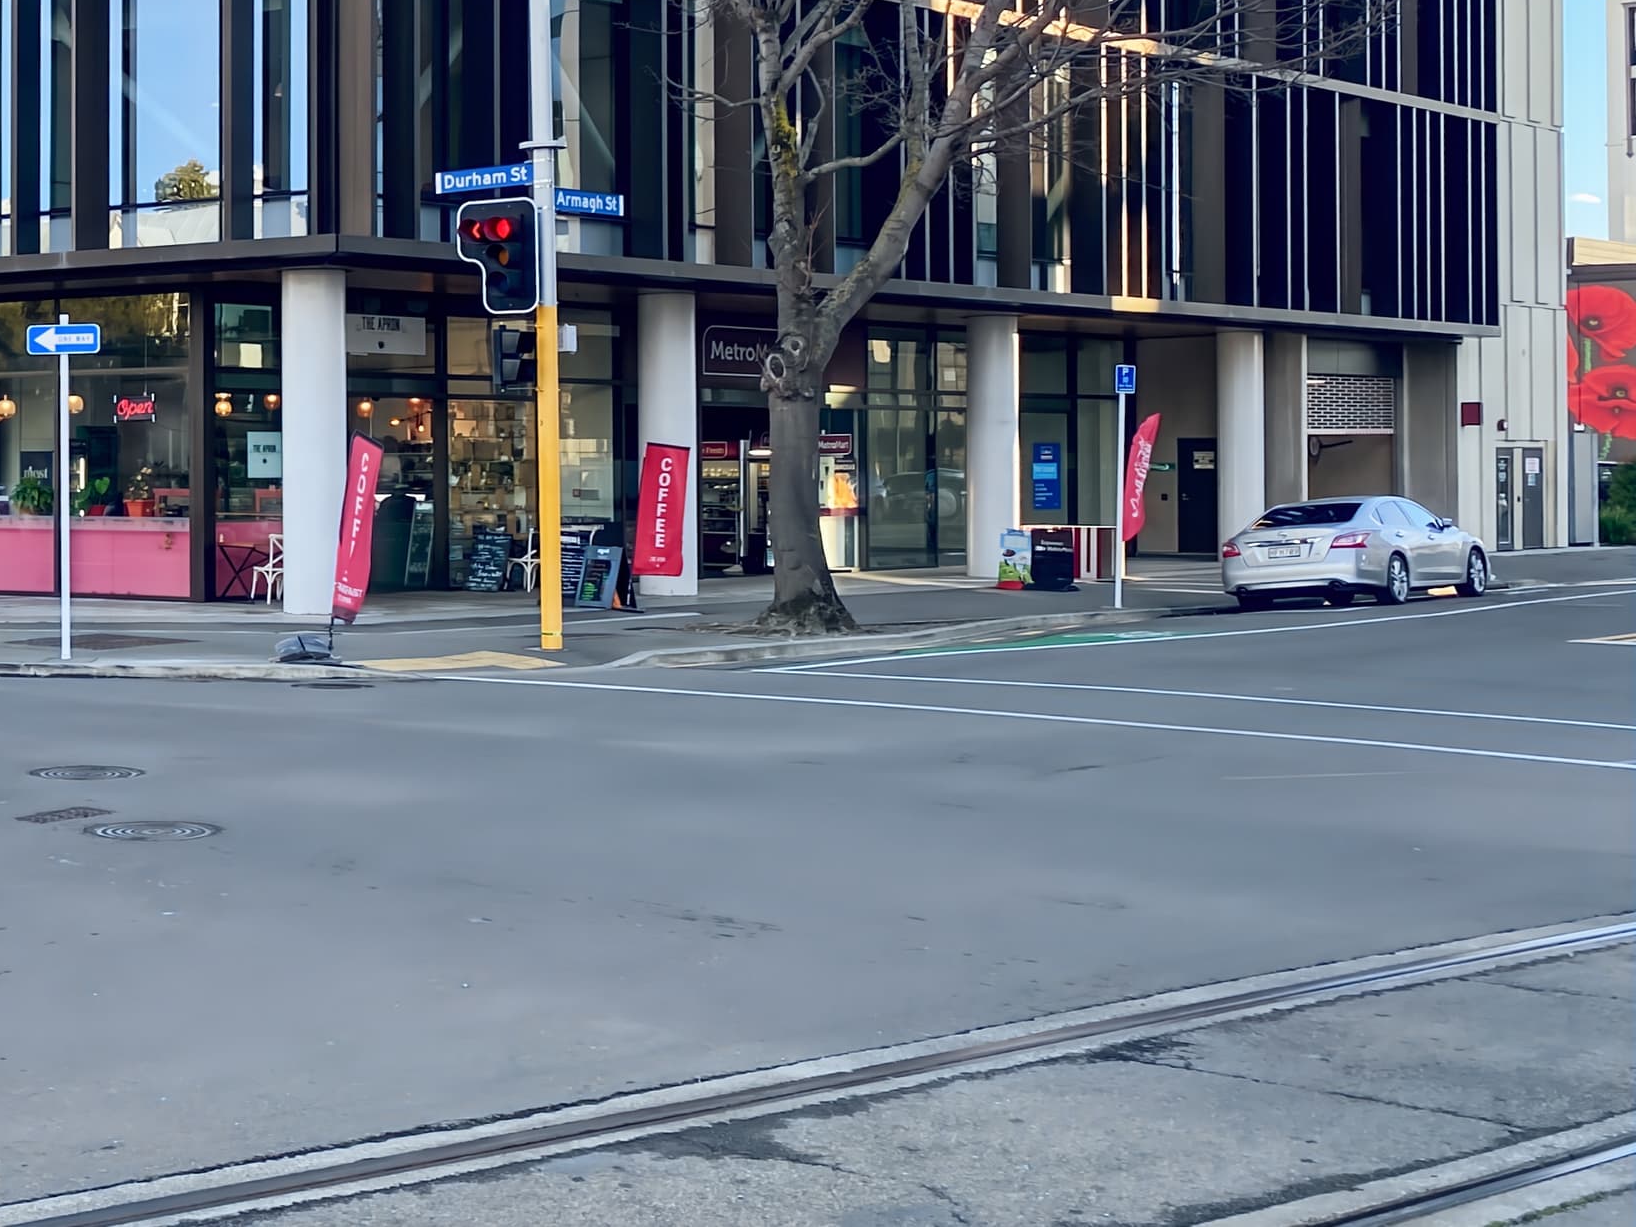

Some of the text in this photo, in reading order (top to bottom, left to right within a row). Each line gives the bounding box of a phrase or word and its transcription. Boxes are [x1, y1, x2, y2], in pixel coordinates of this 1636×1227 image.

[444, 166, 528, 189] Durham St
[556, 191, 618, 213] Armagh St
[117, 398, 154, 420] Open
[655, 457, 673, 548] COFFEE
